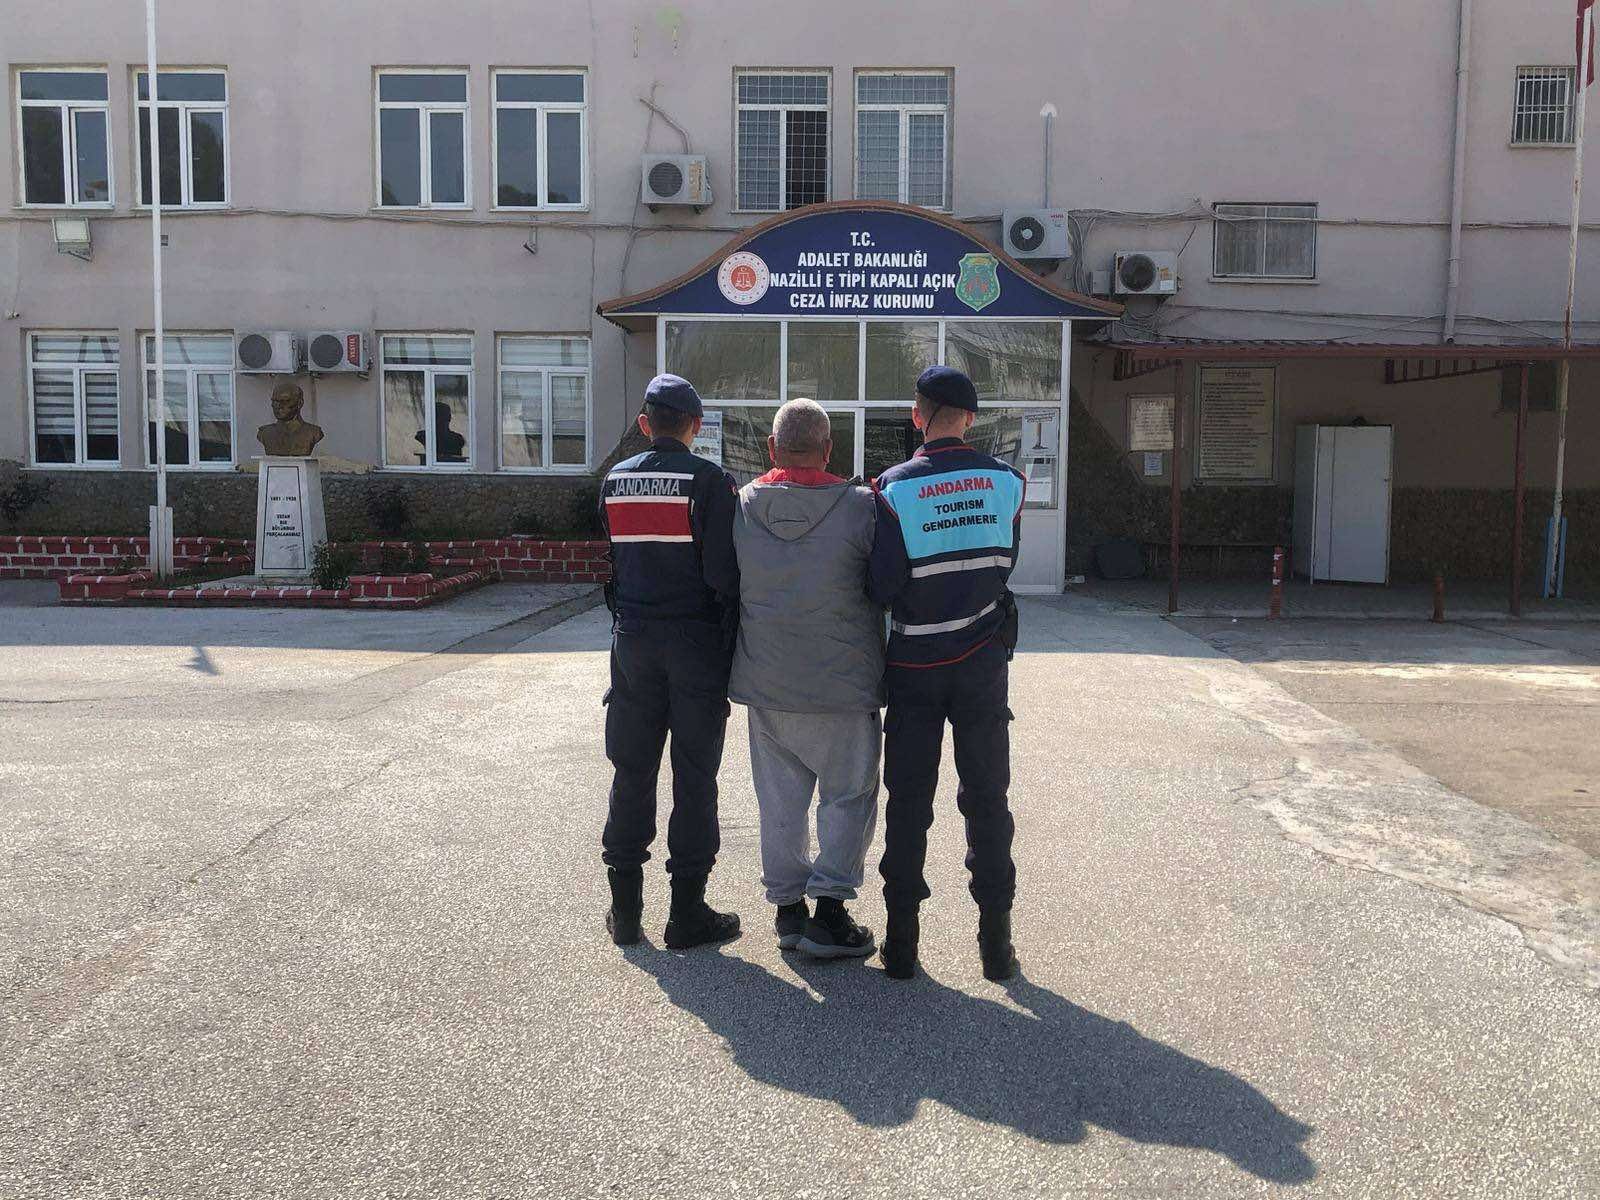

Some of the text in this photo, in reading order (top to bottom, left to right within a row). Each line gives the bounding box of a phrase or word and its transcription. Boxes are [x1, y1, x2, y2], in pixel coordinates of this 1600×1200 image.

[850, 232, 875, 247] T.C.
[797, 250, 928, 267] ADALET BAKANLIĞI
[770, 270, 956, 292] NAZİLLİ E TİPİ KAPALI AÇIK
[790, 291, 935, 309] CEZA İNFAZ KURUMU
[611, 479, 680, 496] JANDARMA
[918, 477, 994, 498] JANDARMA
[934, 499, 985, 515] TOURISM
[922, 514, 998, 532] GENDARMERIE
